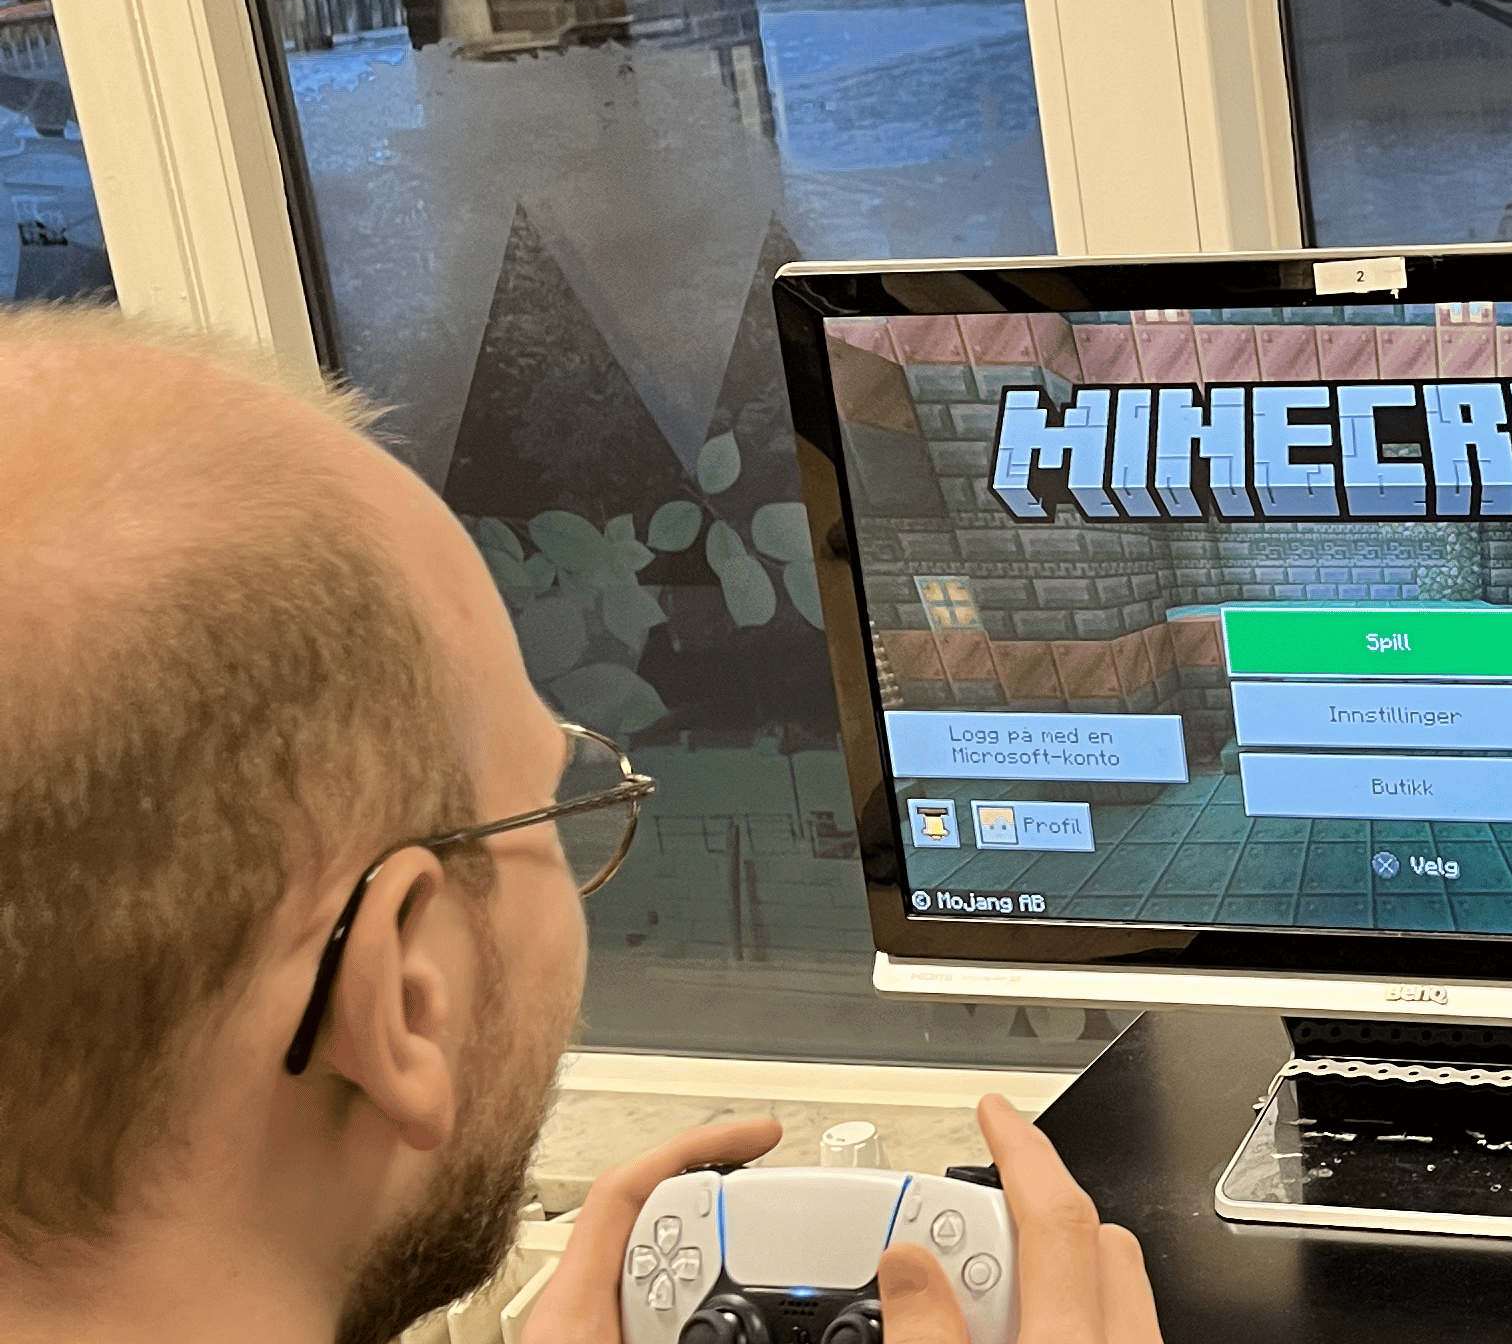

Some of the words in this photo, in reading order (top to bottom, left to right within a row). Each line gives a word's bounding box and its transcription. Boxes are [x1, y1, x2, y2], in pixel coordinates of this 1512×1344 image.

[1356, 270, 1366, 283] 2
[1365, 633, 1412, 653] Spill
[1329, 705, 1463, 727] Innstillinger
[949, 725, 999, 744] Logg
[1008, 727, 1033, 745] på
[1041, 728, 1079, 744] med
[1088, 731, 1113, 744] en
[952, 747, 1120, 767] Microsoft-konto
[1371, 778, 1434, 797] Butikk
[1023, 815, 1083, 835] Profil
[1409, 856, 1461, 879] Velg
[936, 891, 1014, 914] Mojang
[1018, 893, 1046, 913] AB
[1385, 985, 1449, 1006] BenQ
